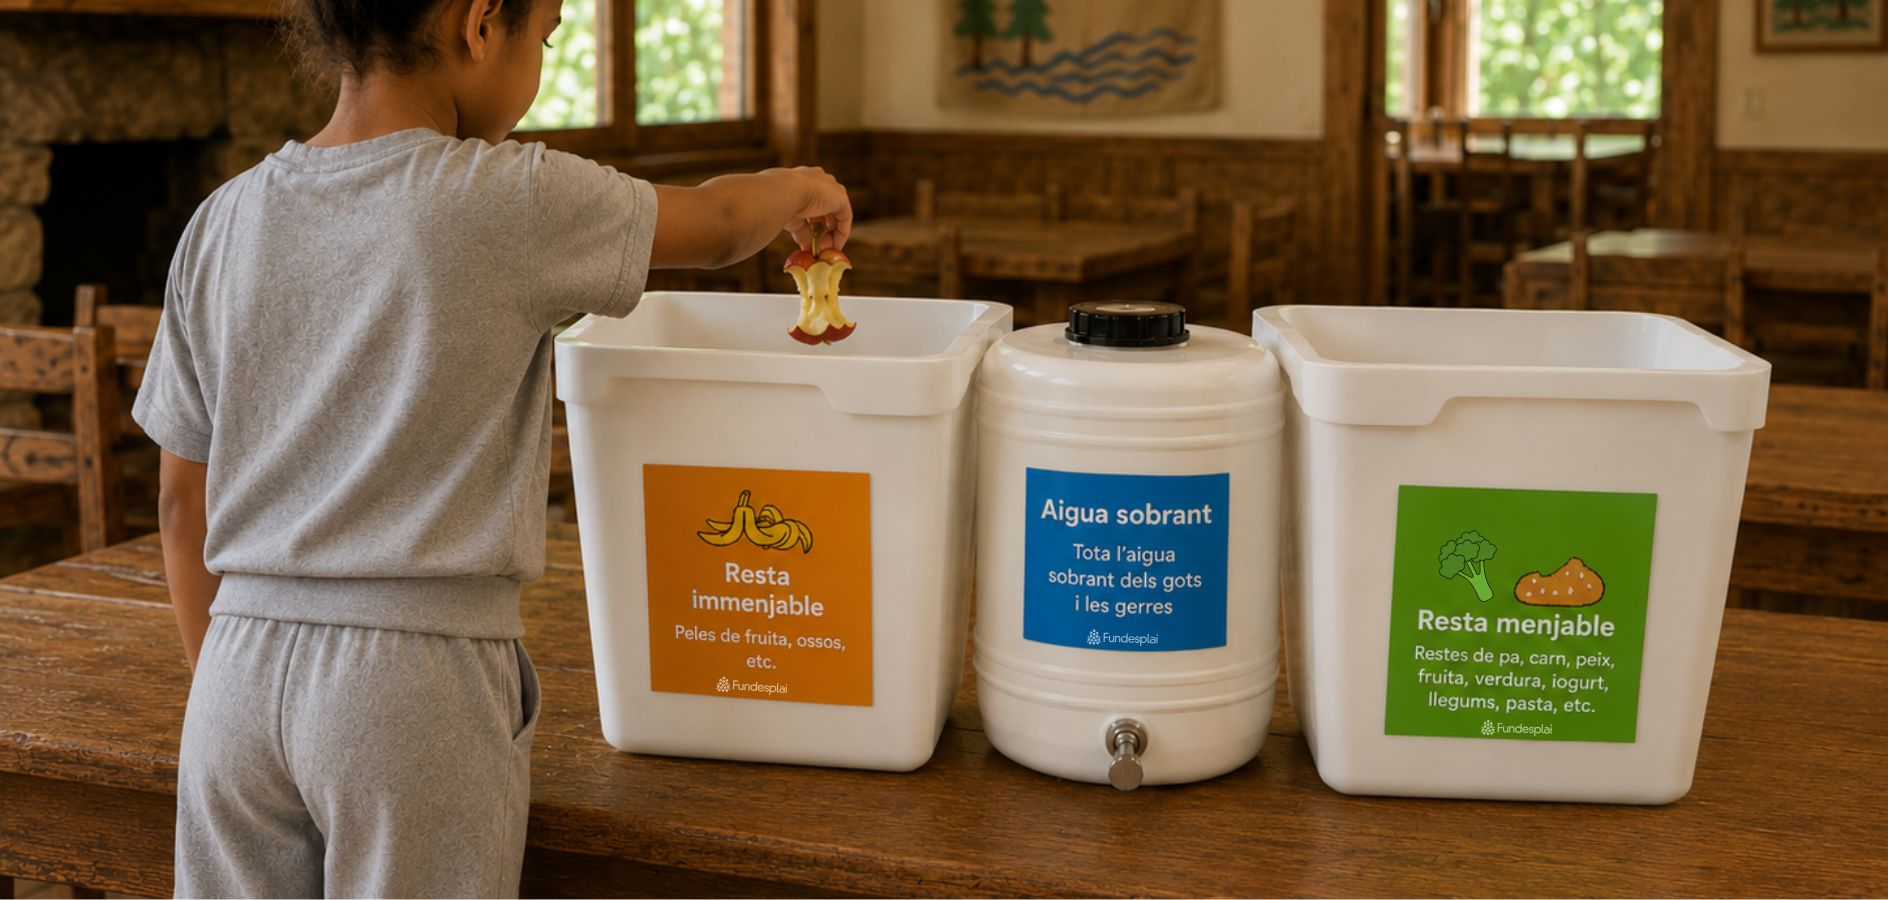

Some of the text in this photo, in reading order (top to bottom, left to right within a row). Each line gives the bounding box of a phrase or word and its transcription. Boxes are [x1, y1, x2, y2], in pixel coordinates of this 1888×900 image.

[1041, 498, 1212, 527] Aigua sobrant
[1073, 543, 1111, 561] Tota
[725, 562, 790, 586] Resta
[1048, 569, 1202, 592] sobrant dels gots
[692, 589, 824, 619] immenjable
[1075, 595, 1173, 617] i les gerres
[1418, 609, 1615, 641] Resta menjable
[675, 625, 846, 652] Peles de fruita, ossos,
[1103, 632, 1158, 646] Fundesplai
[746, 654, 776, 669] etc.
[1415, 646, 1615, 669] Restes de pa, carn, peix,
[732, 680, 788, 696] Fundesplai
[1418, 669, 1609, 693] fruita, verdura, iogurt,
[1428, 691, 1595, 714] llegums, pasta, etc.
[1497, 723, 1552, 736] Fundesplai
